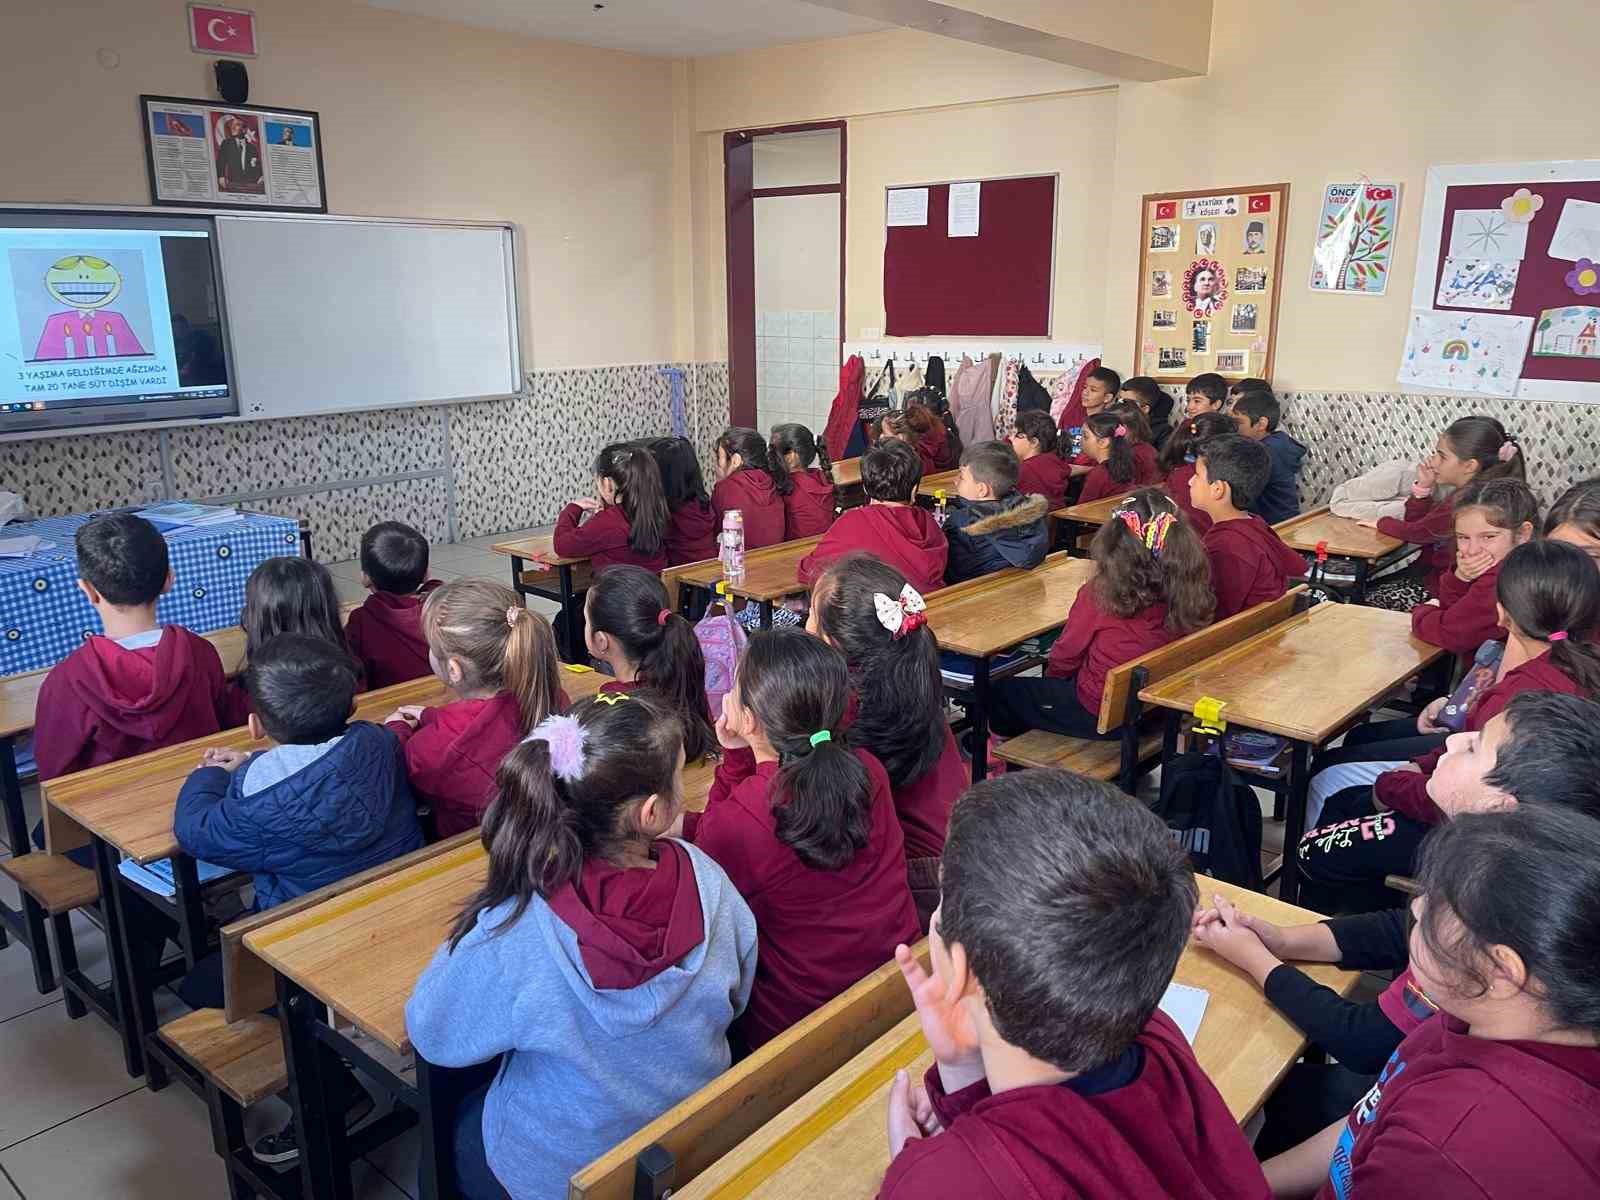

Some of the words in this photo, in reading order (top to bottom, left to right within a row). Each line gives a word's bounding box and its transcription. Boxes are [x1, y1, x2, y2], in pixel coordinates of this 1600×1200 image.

[24, 384, 45, 392] TAM
[47, 382, 59, 391] 20
[62, 381, 87, 390] TANE
